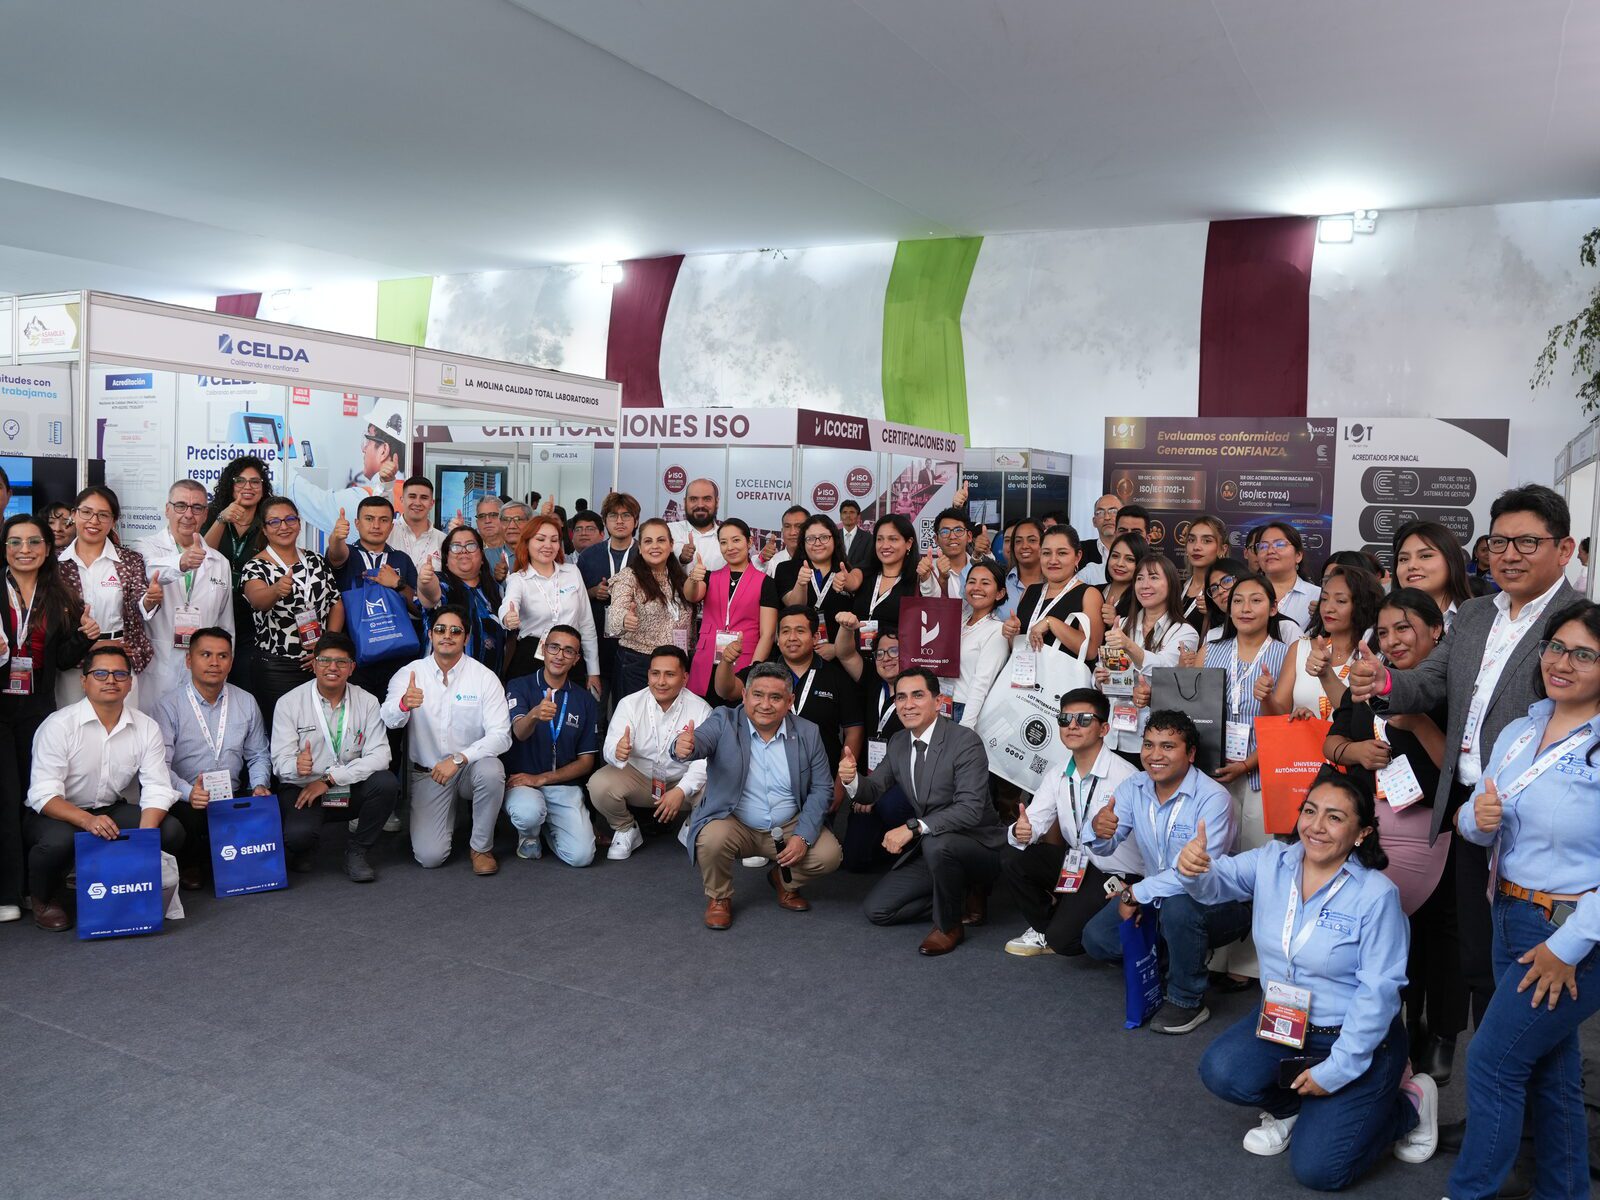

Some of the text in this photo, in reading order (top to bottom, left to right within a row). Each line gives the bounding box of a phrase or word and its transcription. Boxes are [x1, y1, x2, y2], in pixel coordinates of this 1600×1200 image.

[237, 340, 309, 363] CELDA
[230, 359, 263, 369] Calibrando
[273, 364, 299, 373] confianza
[0, 373, 51, 387] itudes con
[112, 377, 146, 387] Acreditación
[2, 386, 57, 399] trabajamos
[465, 378, 599, 406] LA MOLINA CALIDAD TOTAL LABORATORIOS
[705, 414, 750, 438] ISO
[823, 421, 864, 440] ICOCERT
[882, 428, 956, 453] CERTIFICACIONES ISO
[1157, 430, 1290, 442] Evaluamos conformidad
[187, 444, 244, 461] Precisón
[1157, 445, 1218, 456] Generamos
[735, 478, 792, 489] EXCELENCIA
[1139, 484, 1185, 494] ISO/IEC 17021-1
[736, 491, 791, 501] OPERATIVA
[1239, 488, 1290, 501] (ISO/IEC 17024)
[127, 522, 157, 530] innovación
[1027, 693, 1036, 701] LOT
[1275, 766, 1308, 774] AUTÓNOMA
[240, 842, 276, 855] SENATI
[111, 881, 153, 895] SENATI
